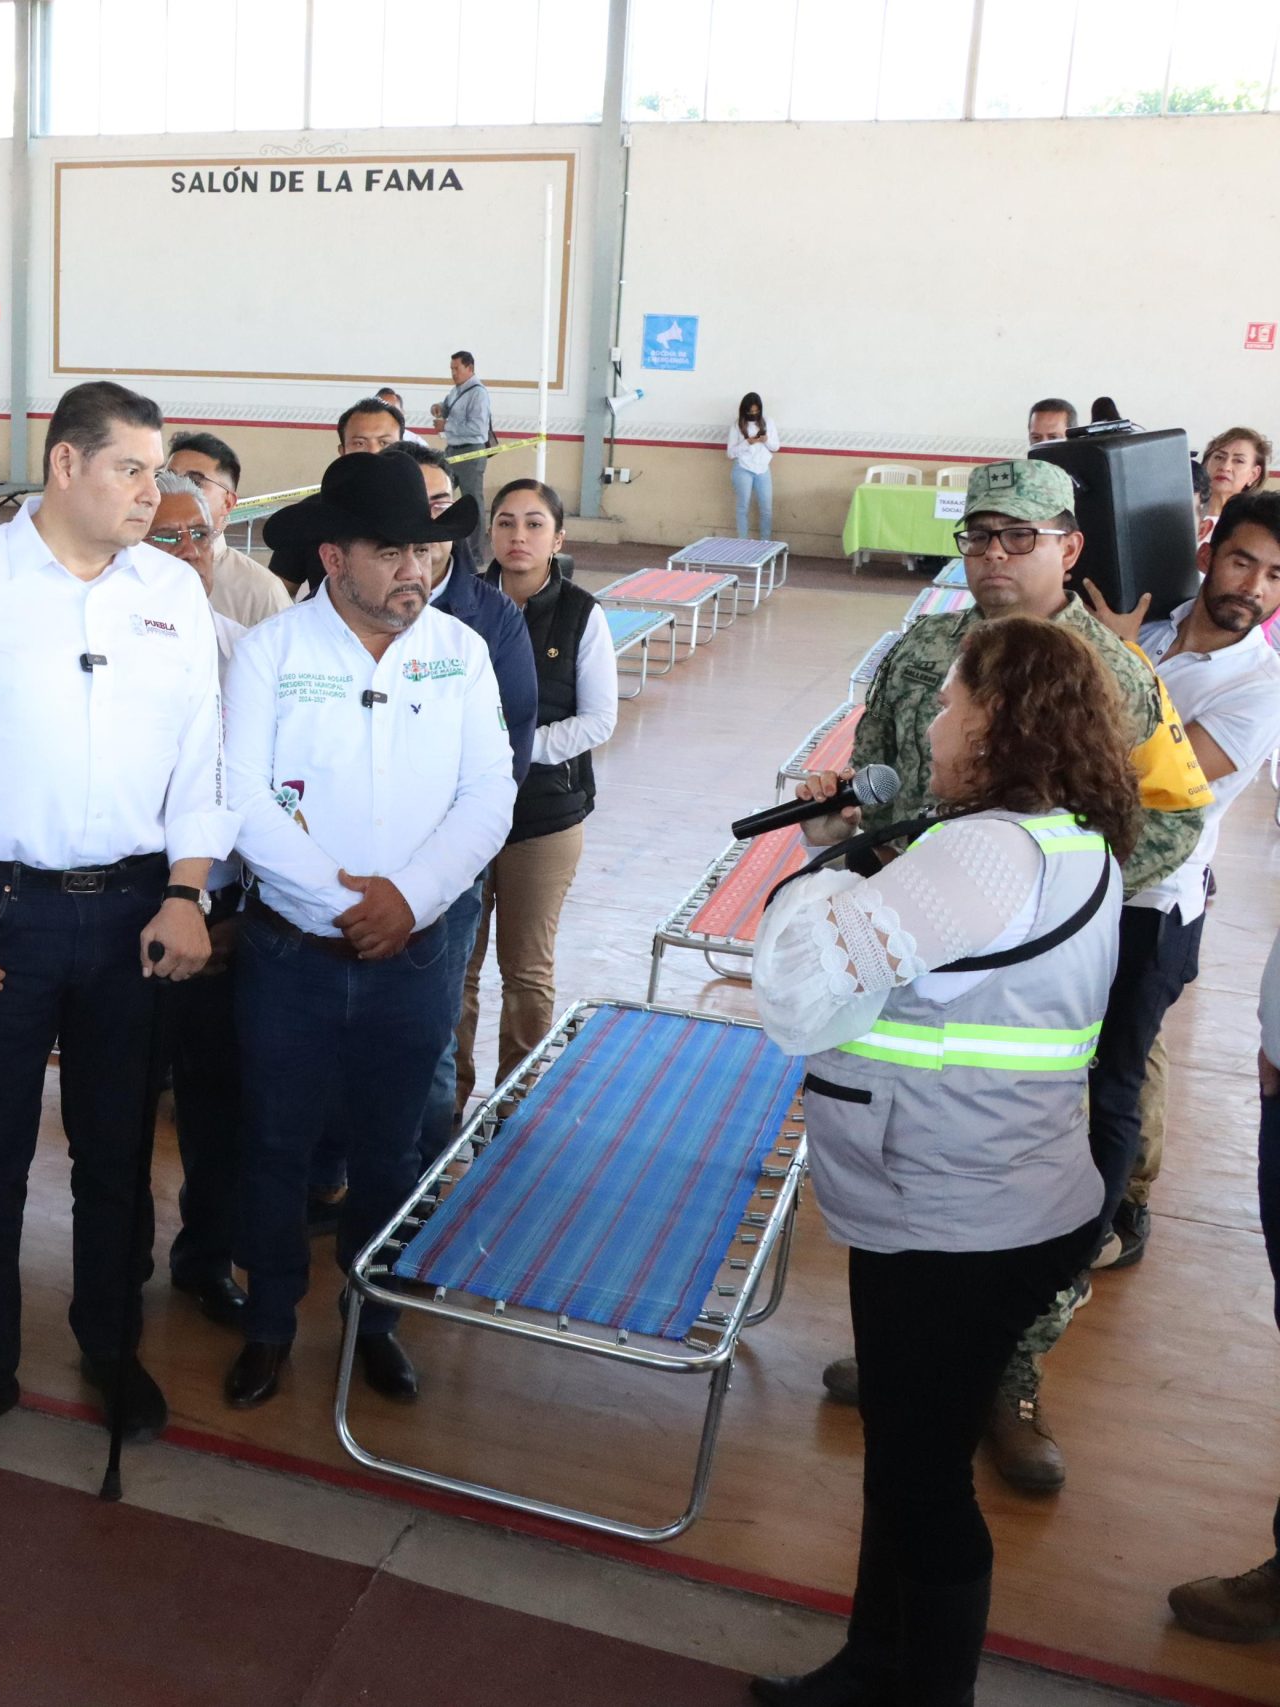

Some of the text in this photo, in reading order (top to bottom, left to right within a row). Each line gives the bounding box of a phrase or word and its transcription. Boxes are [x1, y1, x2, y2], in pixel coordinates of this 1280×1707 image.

[171, 166, 464, 193] SALÓN DE LA FAMA
[144, 619, 176, 632] PUEBLA
[280, 680, 312, 689] PRESIDENTE
